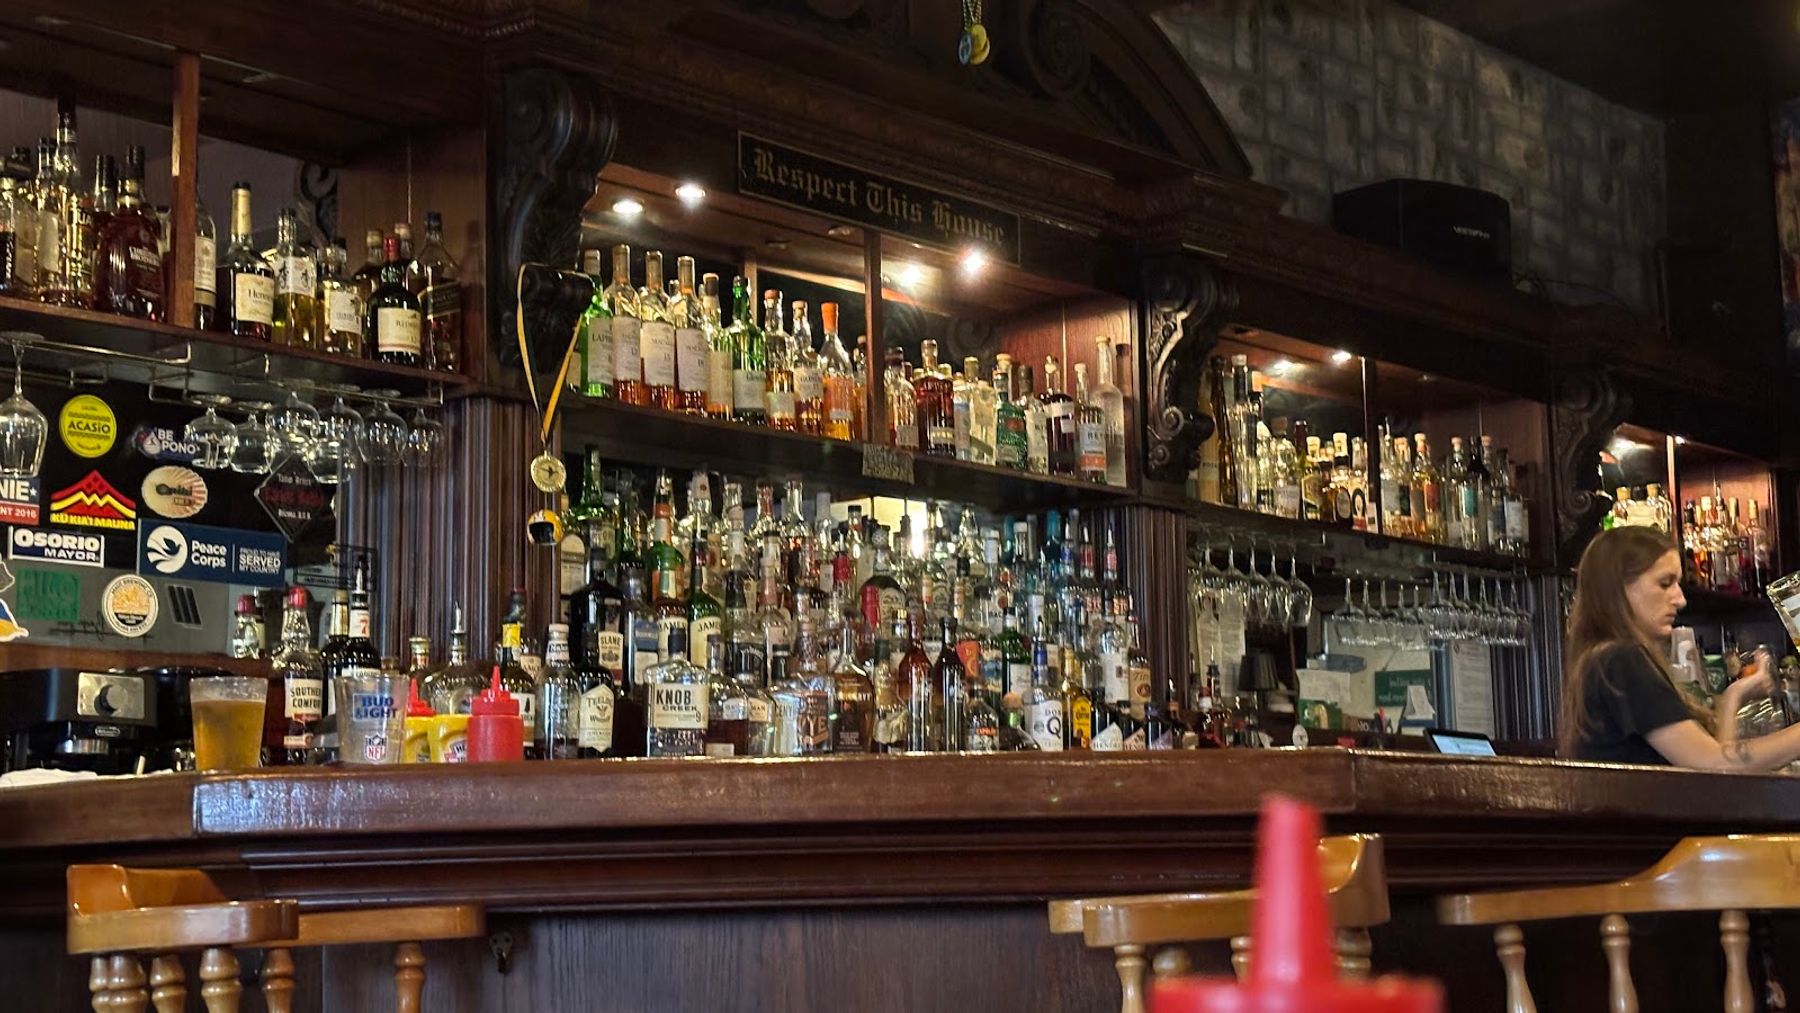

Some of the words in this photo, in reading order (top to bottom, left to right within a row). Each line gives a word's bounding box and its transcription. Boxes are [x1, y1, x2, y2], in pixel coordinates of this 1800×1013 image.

[754, 147, 857, 207] Respect
[866, 180, 923, 224] This
[932, 199, 1005, 246] House
[157, 428, 174, 441] BE
[162, 440, 196, 455] PONO
[14, 528, 101, 552] OSORIO
[44, 547, 97, 562] MAYOR
[191, 540, 228, 556] Peace
[191, 552, 227, 569] Corps
[239, 554, 281, 568] SERVED
[361, 695, 395, 707] BUD
[656, 688, 693, 705] KNOB
[354, 706, 398, 719] LIGHT
[1046, 716, 1062, 740] Q
[366, 745, 387, 760] NFL
